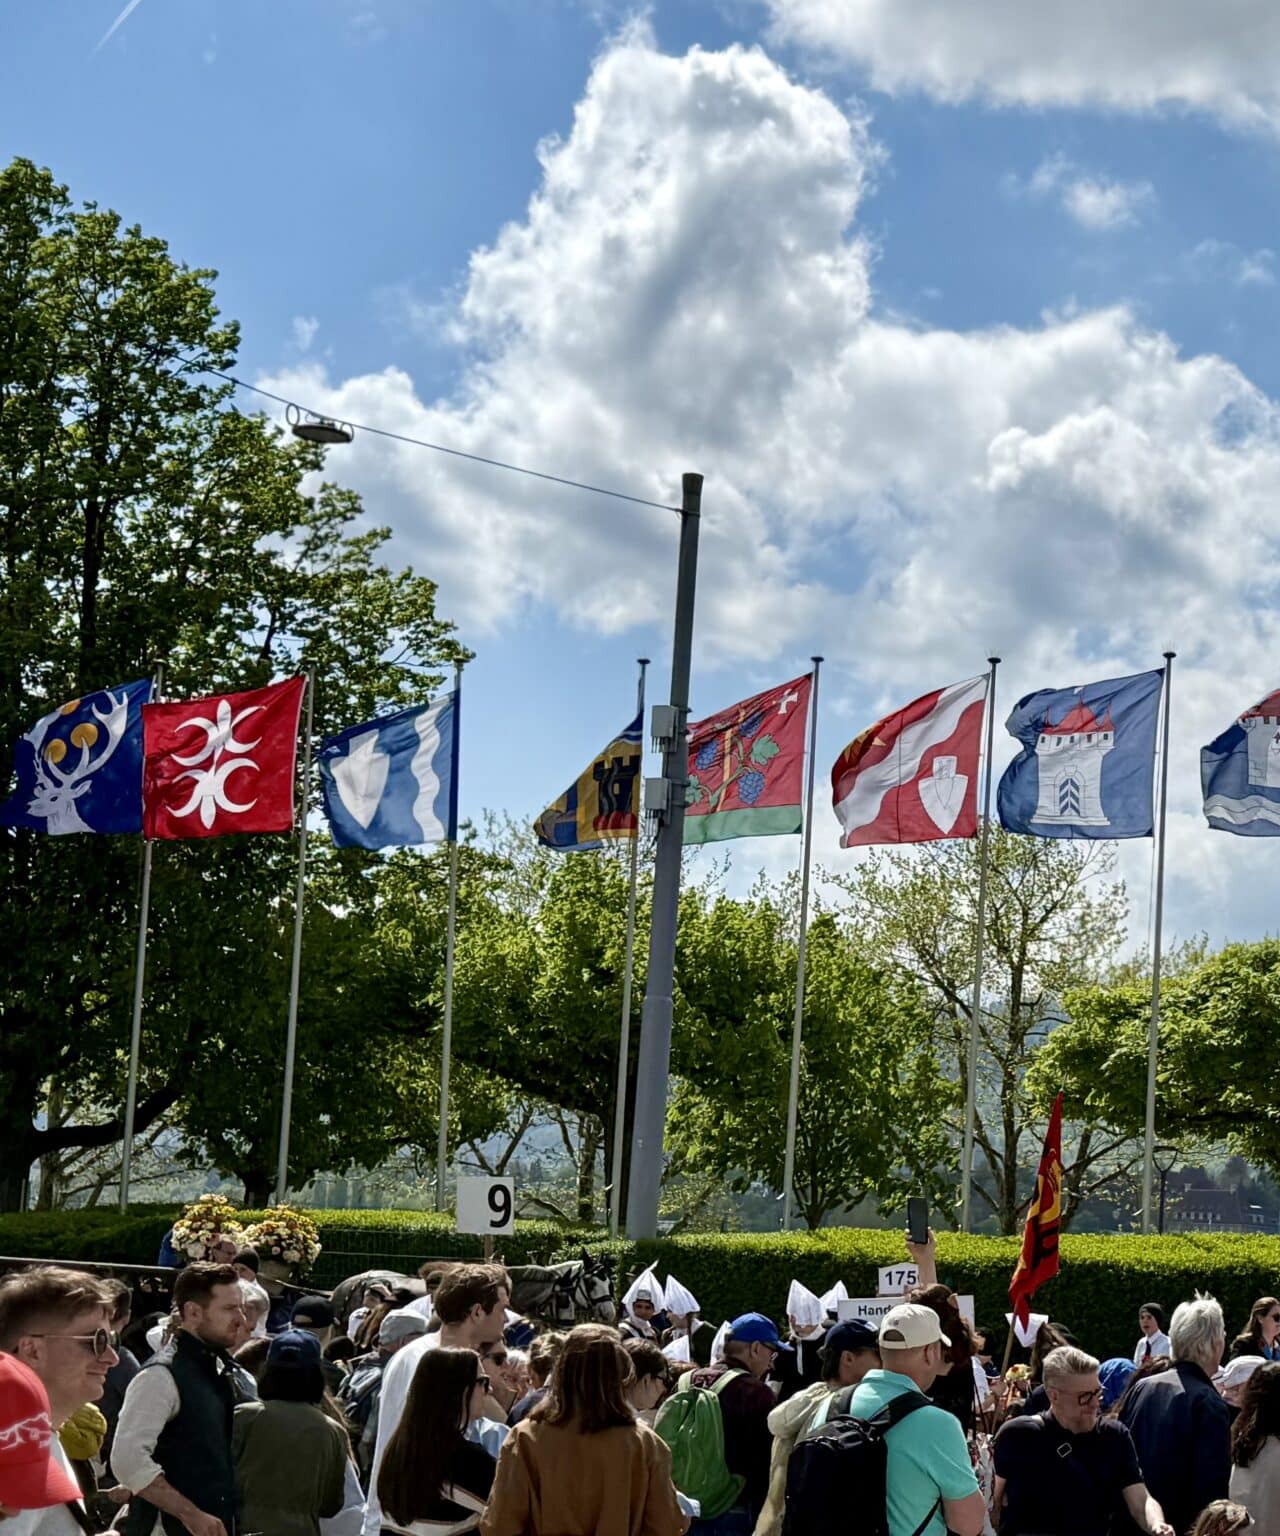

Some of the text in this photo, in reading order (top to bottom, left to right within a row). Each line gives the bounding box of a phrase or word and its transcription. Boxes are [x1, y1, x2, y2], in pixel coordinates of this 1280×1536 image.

[488, 1184, 511, 1228] 9
[885, 1270, 919, 1286] 175
[858, 1304, 894, 1316] Hand
